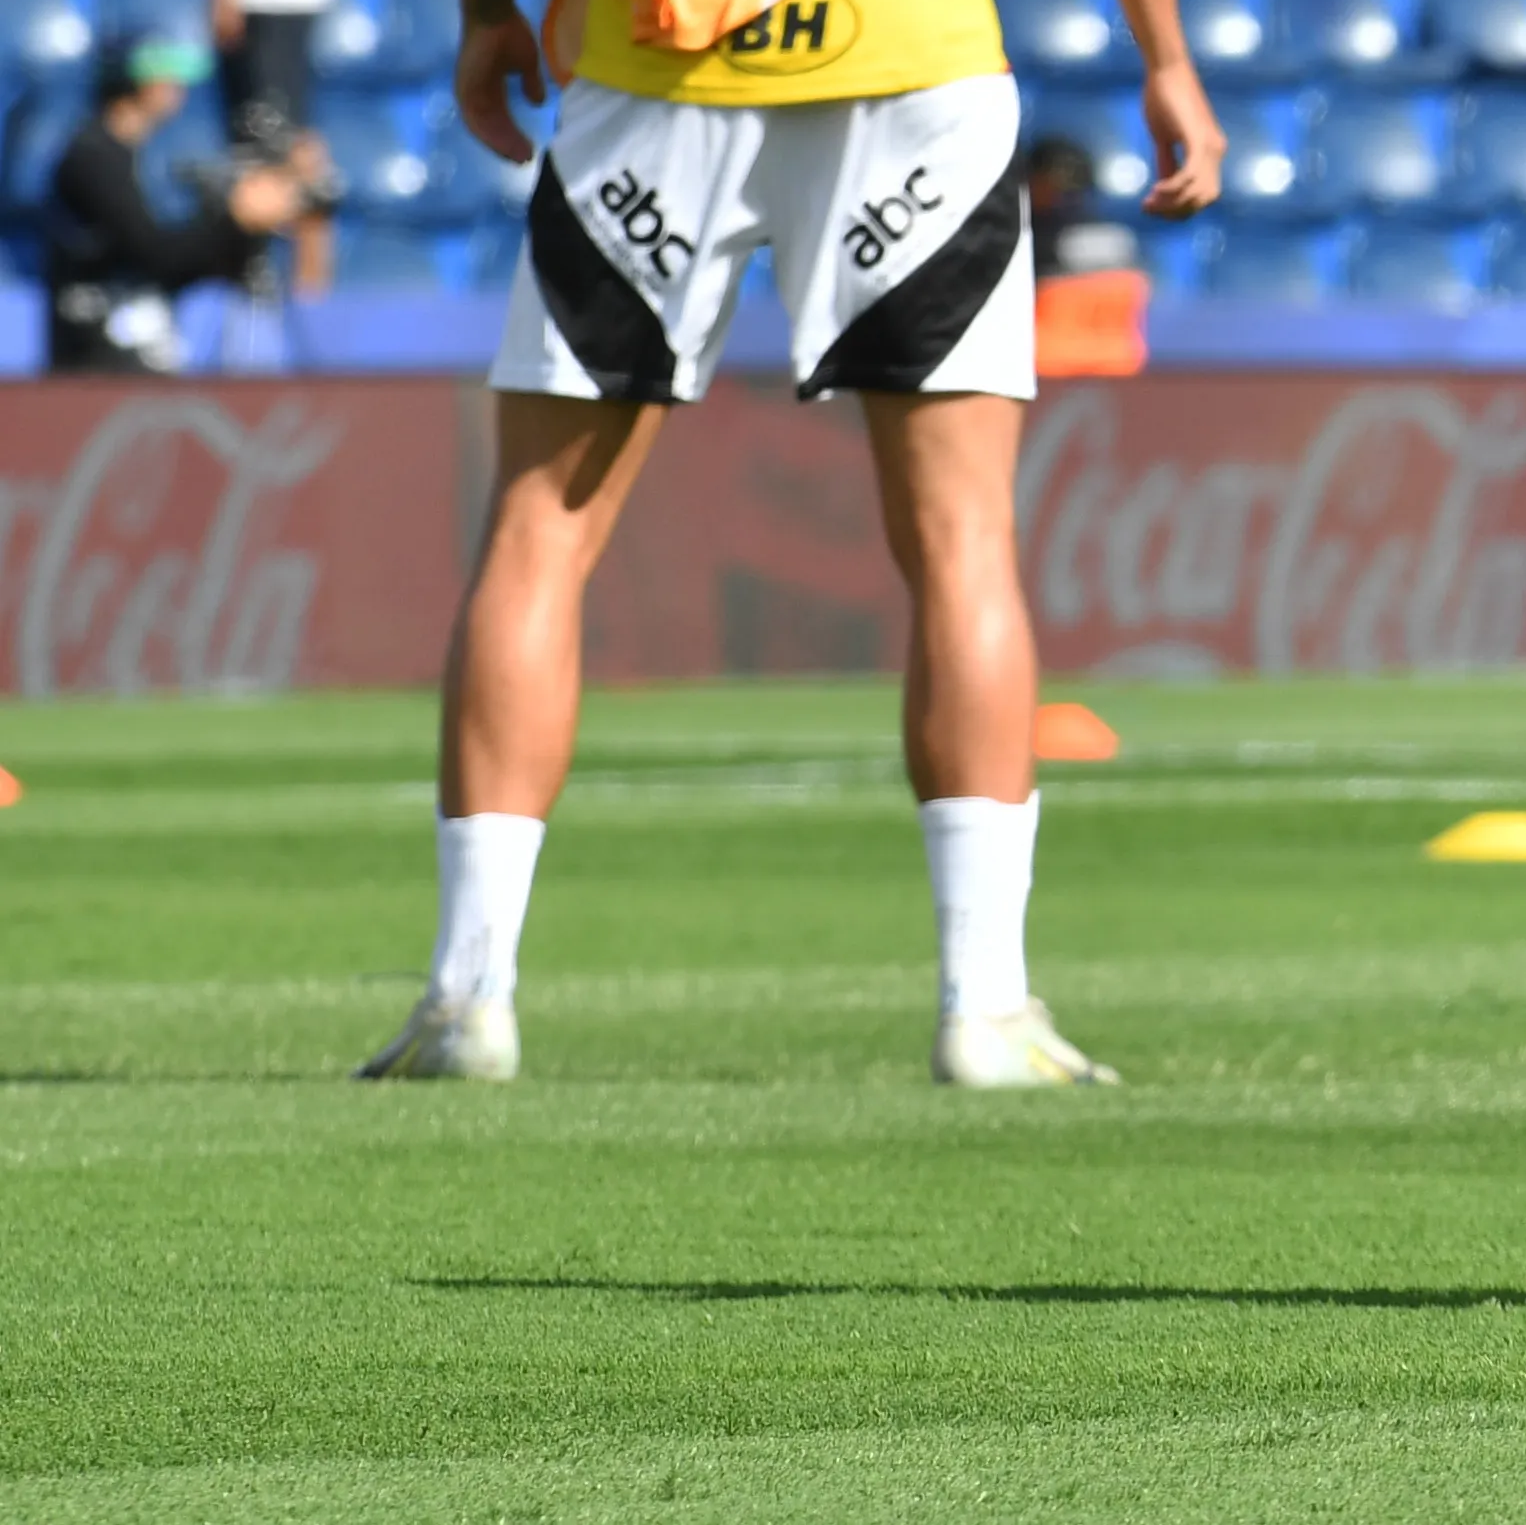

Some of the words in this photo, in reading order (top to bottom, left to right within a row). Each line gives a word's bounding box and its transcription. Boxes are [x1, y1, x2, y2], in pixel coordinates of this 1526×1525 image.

[731, 0, 829, 53] BH
[600, 168, 696, 279] abc
[843, 165, 944, 270] abc
